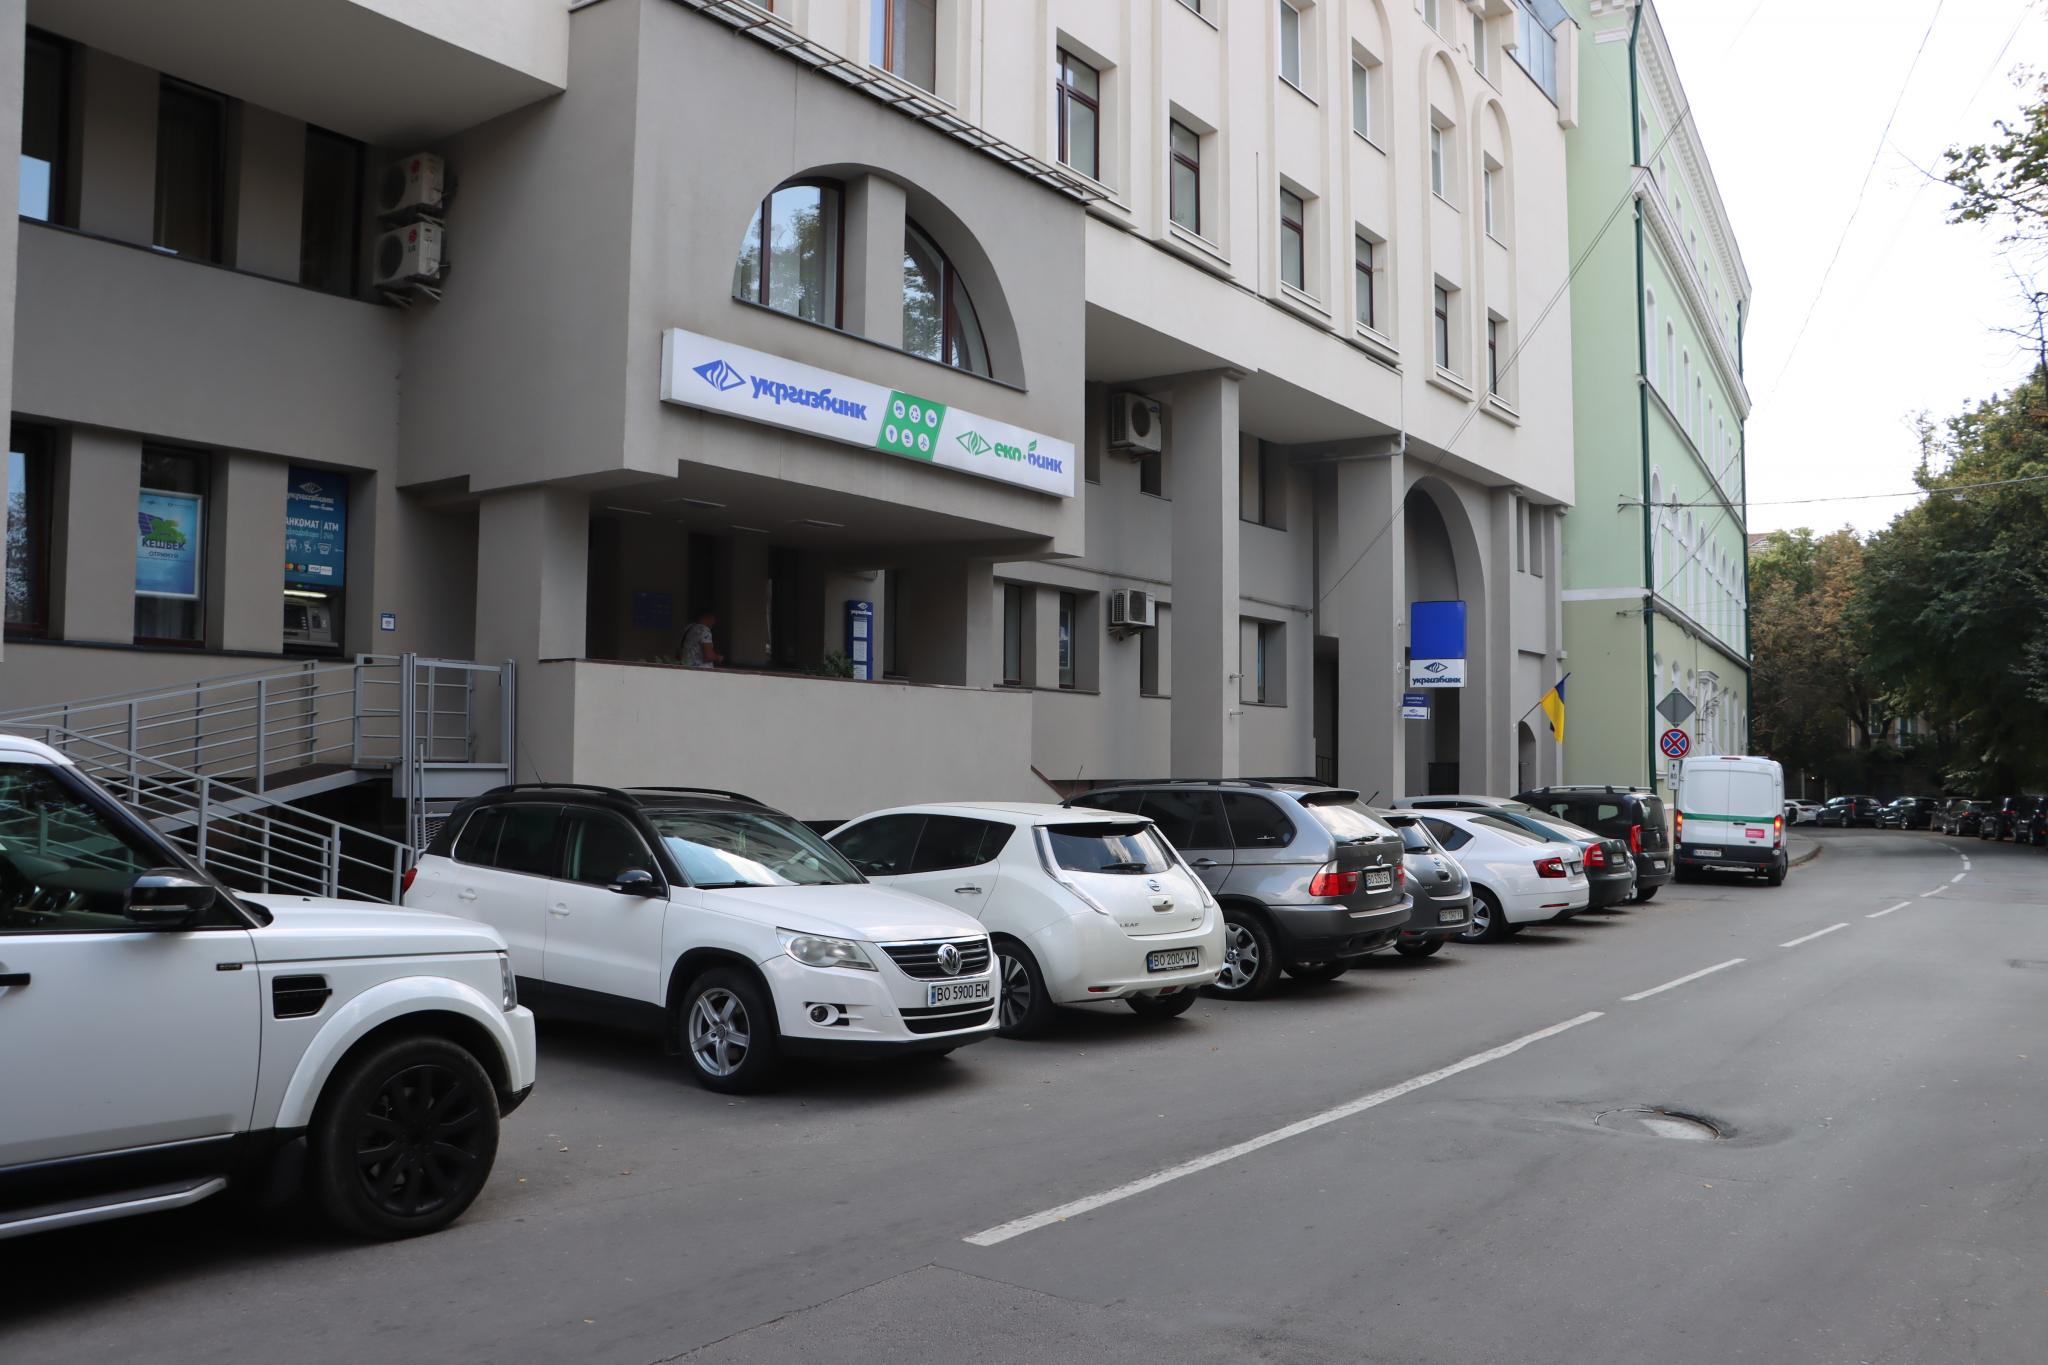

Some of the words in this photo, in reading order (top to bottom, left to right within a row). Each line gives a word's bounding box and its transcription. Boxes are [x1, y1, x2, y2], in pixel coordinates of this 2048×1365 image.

[750, 375, 867, 420] укргазбанк
[286, 517, 320, 529] АНКОМАТ
[1154, 953, 1165, 967] BO
[1167, 952, 1184, 966] 2004
[1186, 950, 1197, 963] YA
[937, 987, 951, 1001] BO
[953, 985, 974, 1000] 5900
[975, 983, 988, 998] EM
